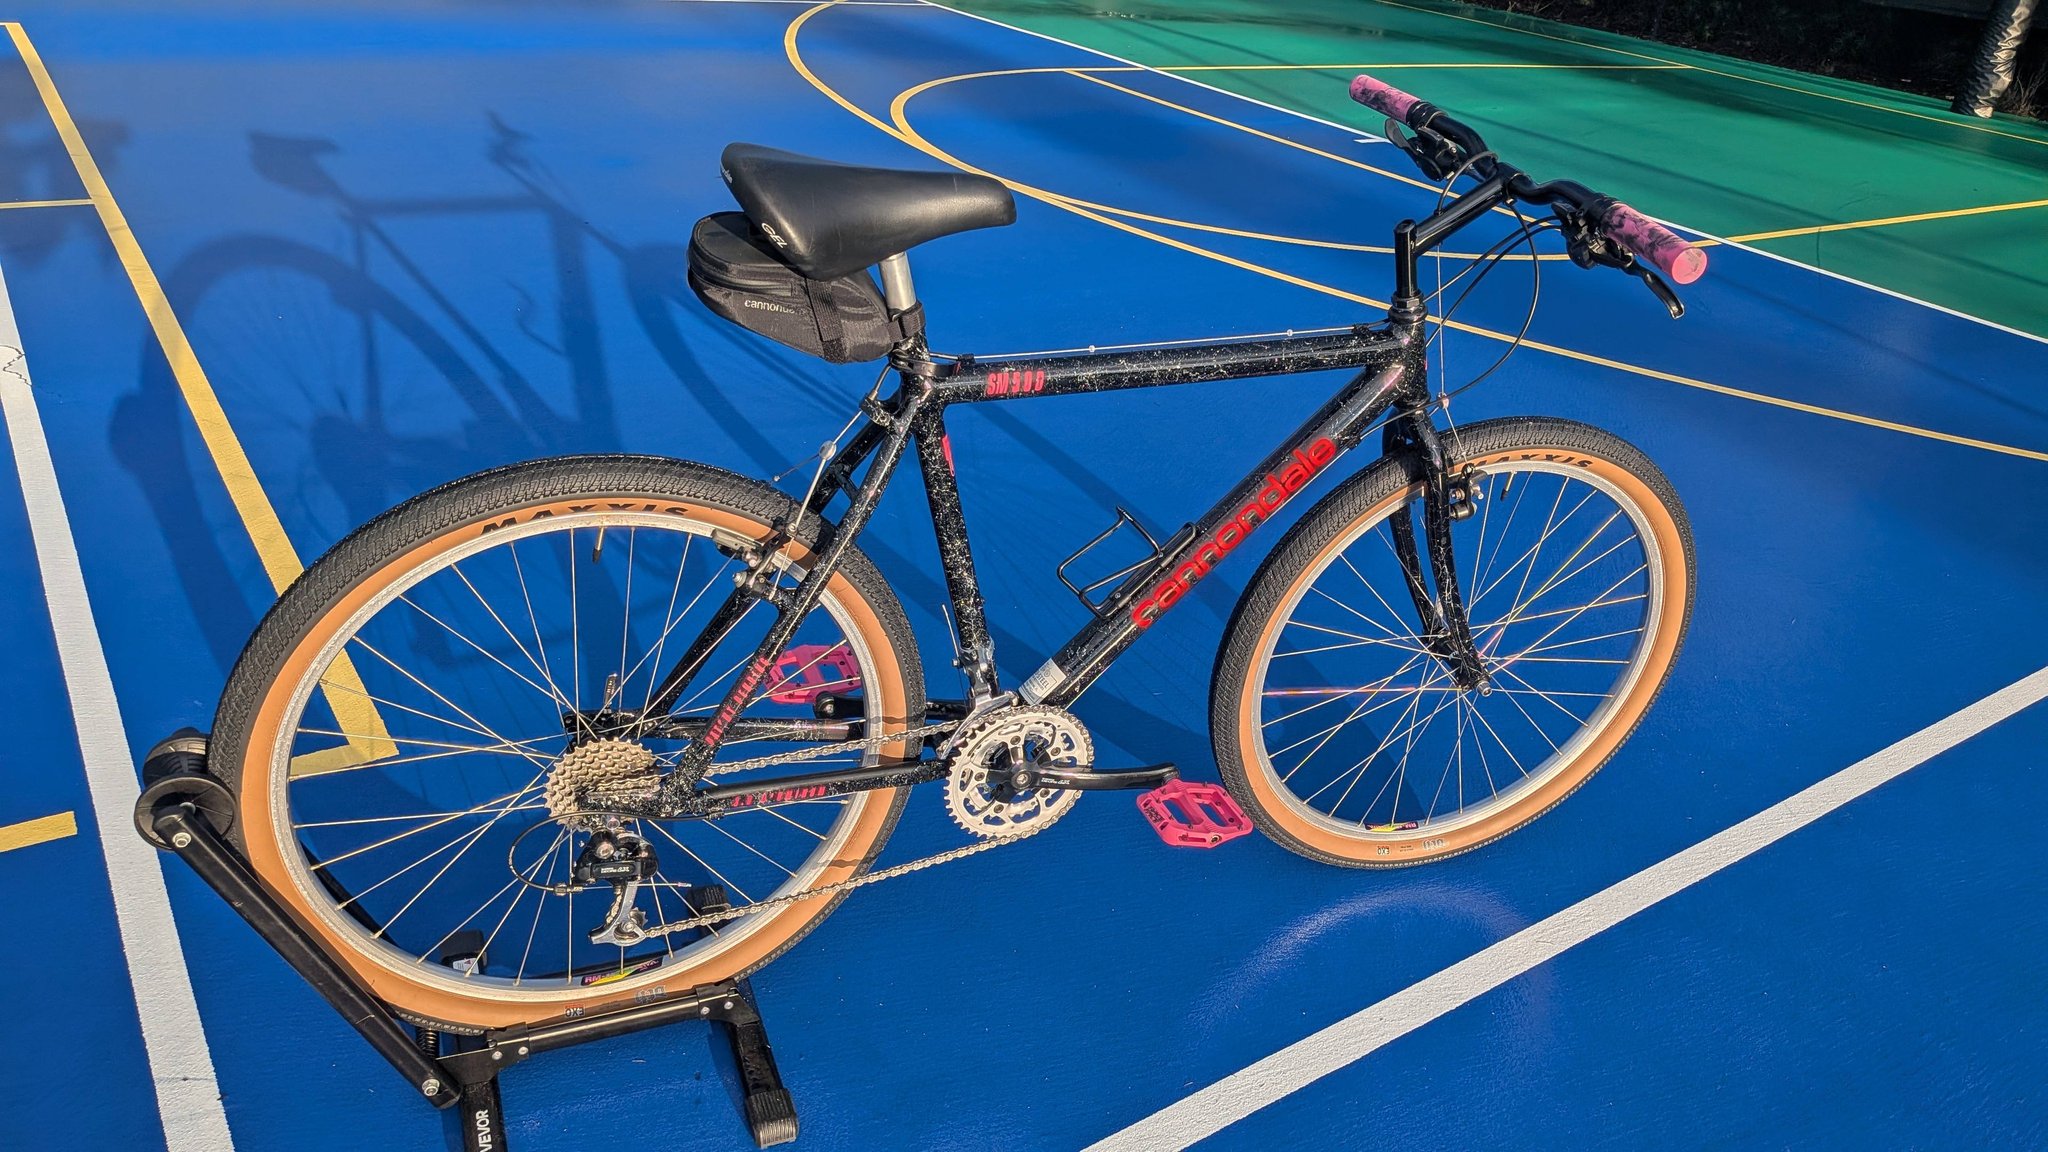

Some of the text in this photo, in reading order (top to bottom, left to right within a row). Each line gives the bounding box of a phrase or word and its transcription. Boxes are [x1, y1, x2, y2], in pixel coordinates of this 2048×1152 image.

[762, 223, 787, 248] GEL
[480, 503, 689, 536] MAXXIS
[1131, 437, 1336, 629] cannondale
[475, 1109, 493, 1152] VEVOR
